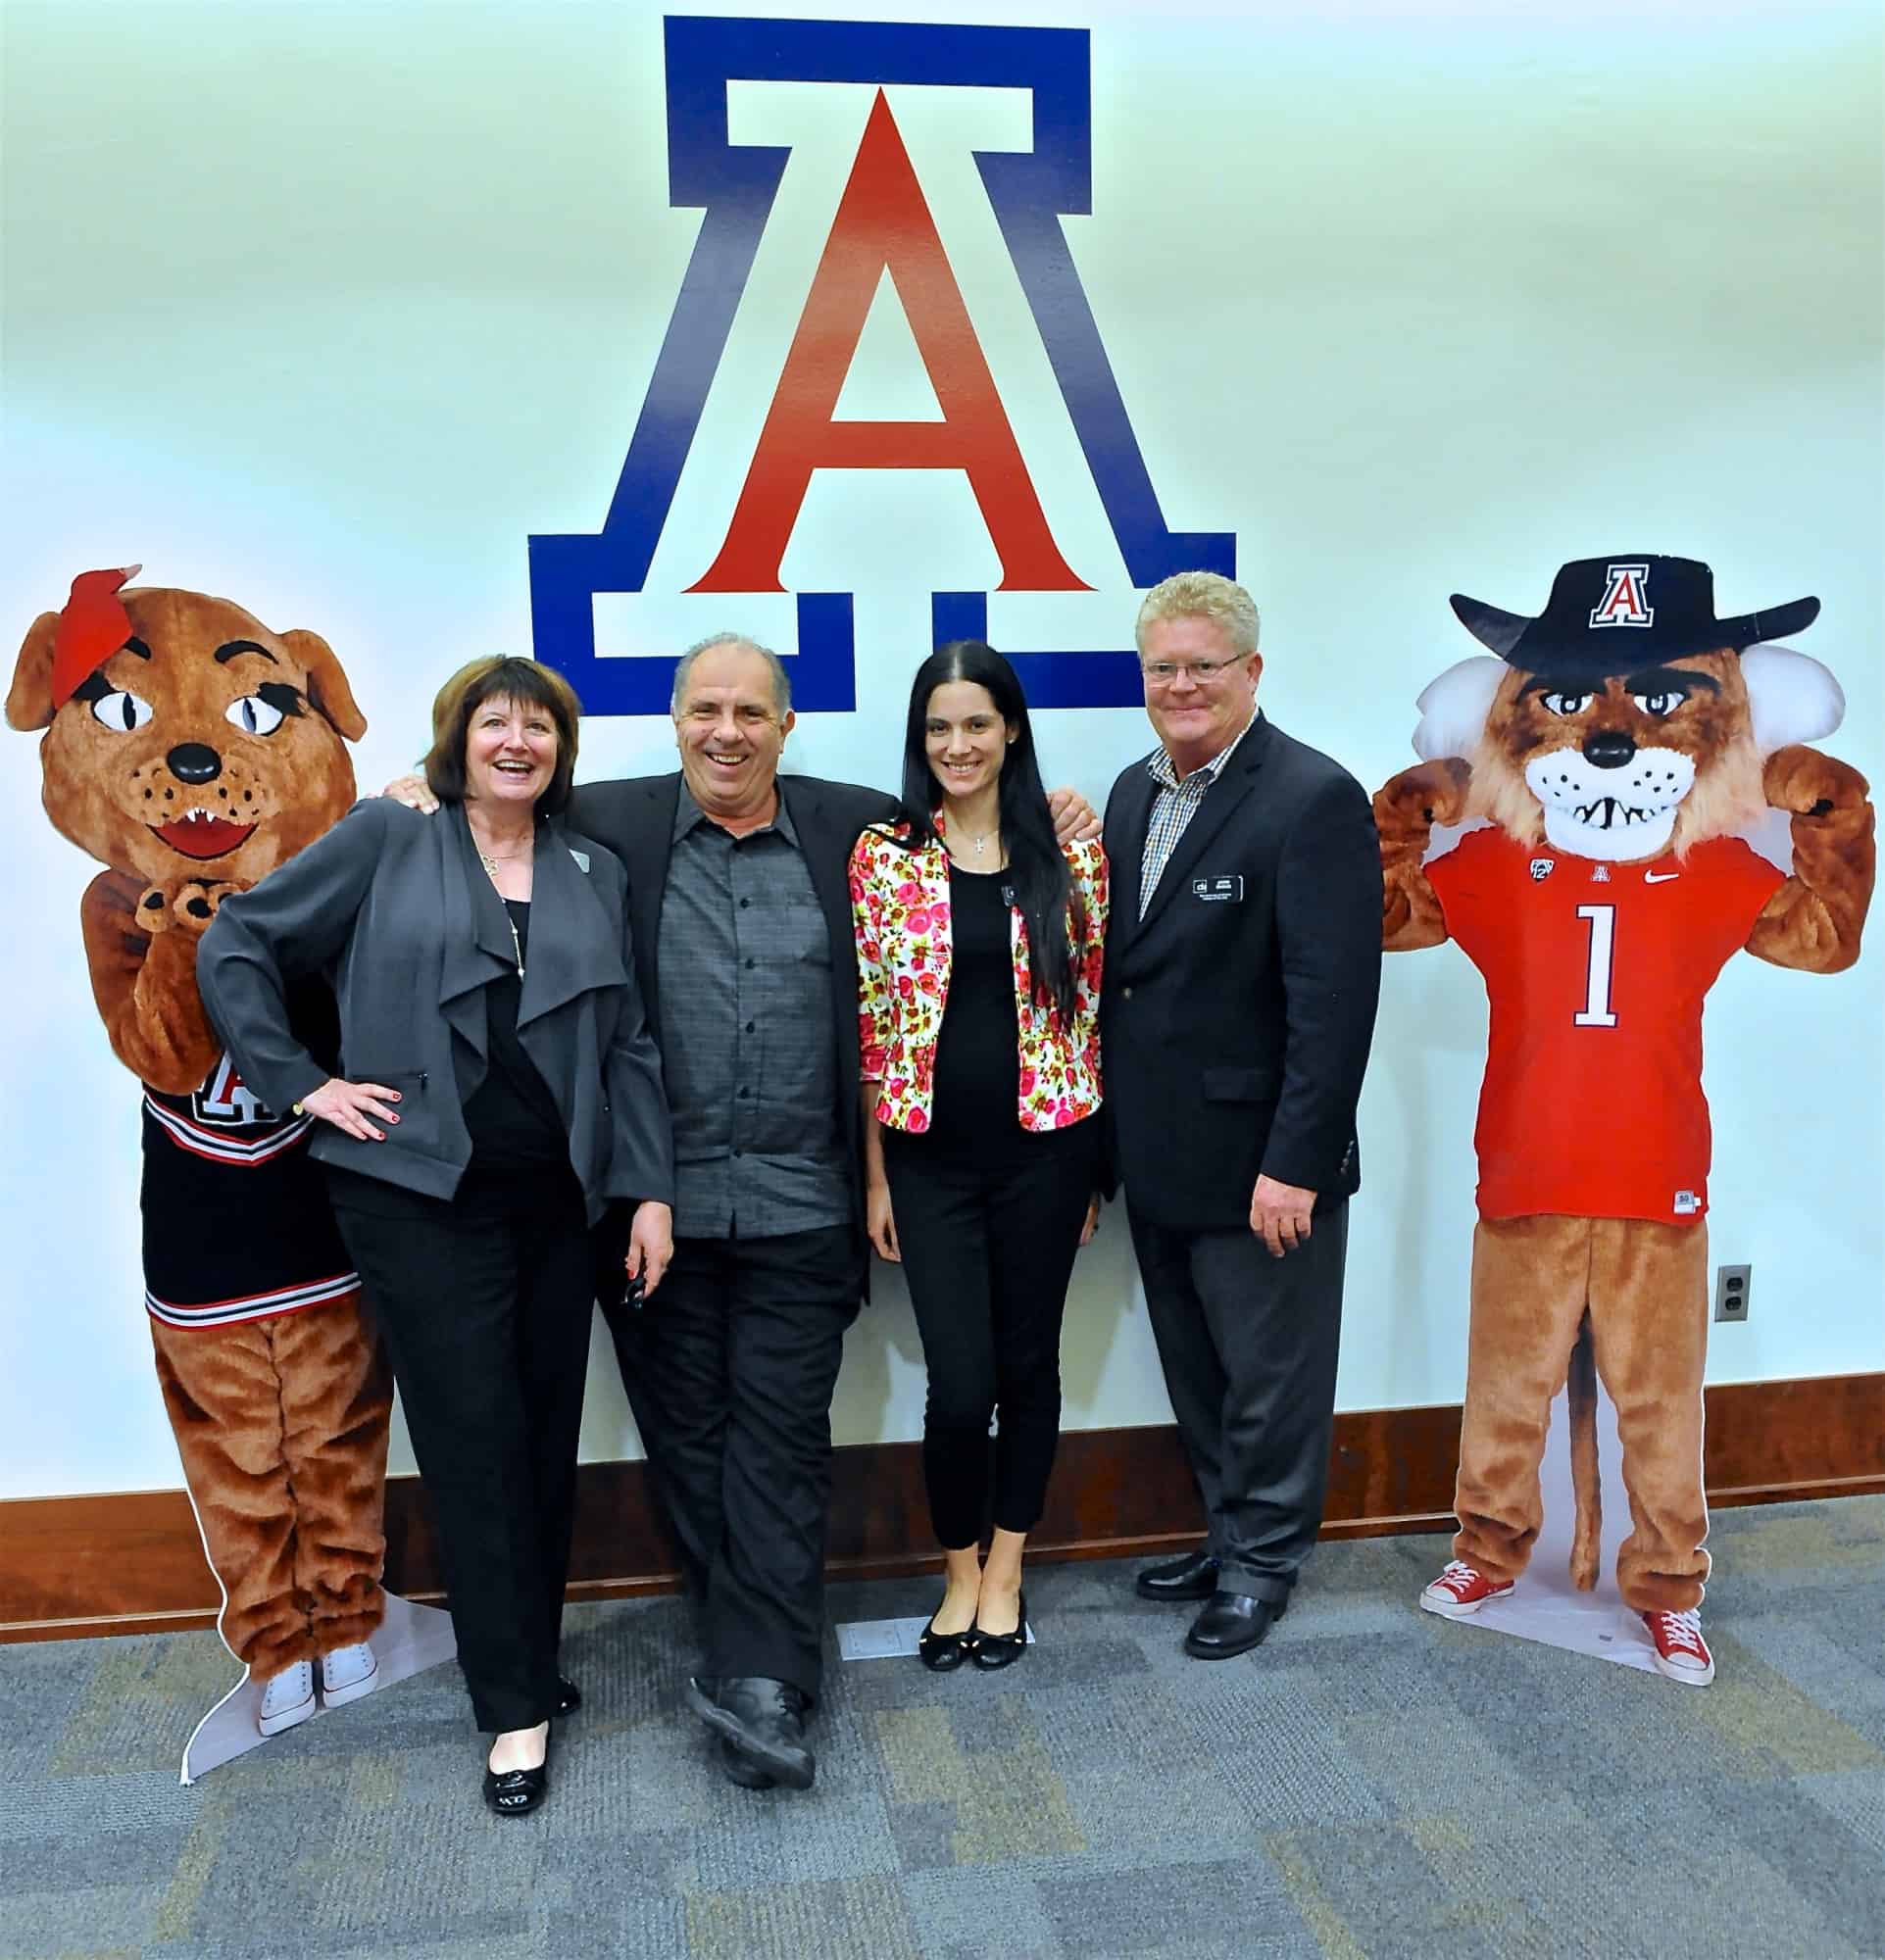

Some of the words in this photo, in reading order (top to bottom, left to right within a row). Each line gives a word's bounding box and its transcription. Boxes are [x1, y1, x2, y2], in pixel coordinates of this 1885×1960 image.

[527, 15, 1238, 716] A
[1589, 564, 1654, 628] A
[1573, 904, 1616, 1028] 1
